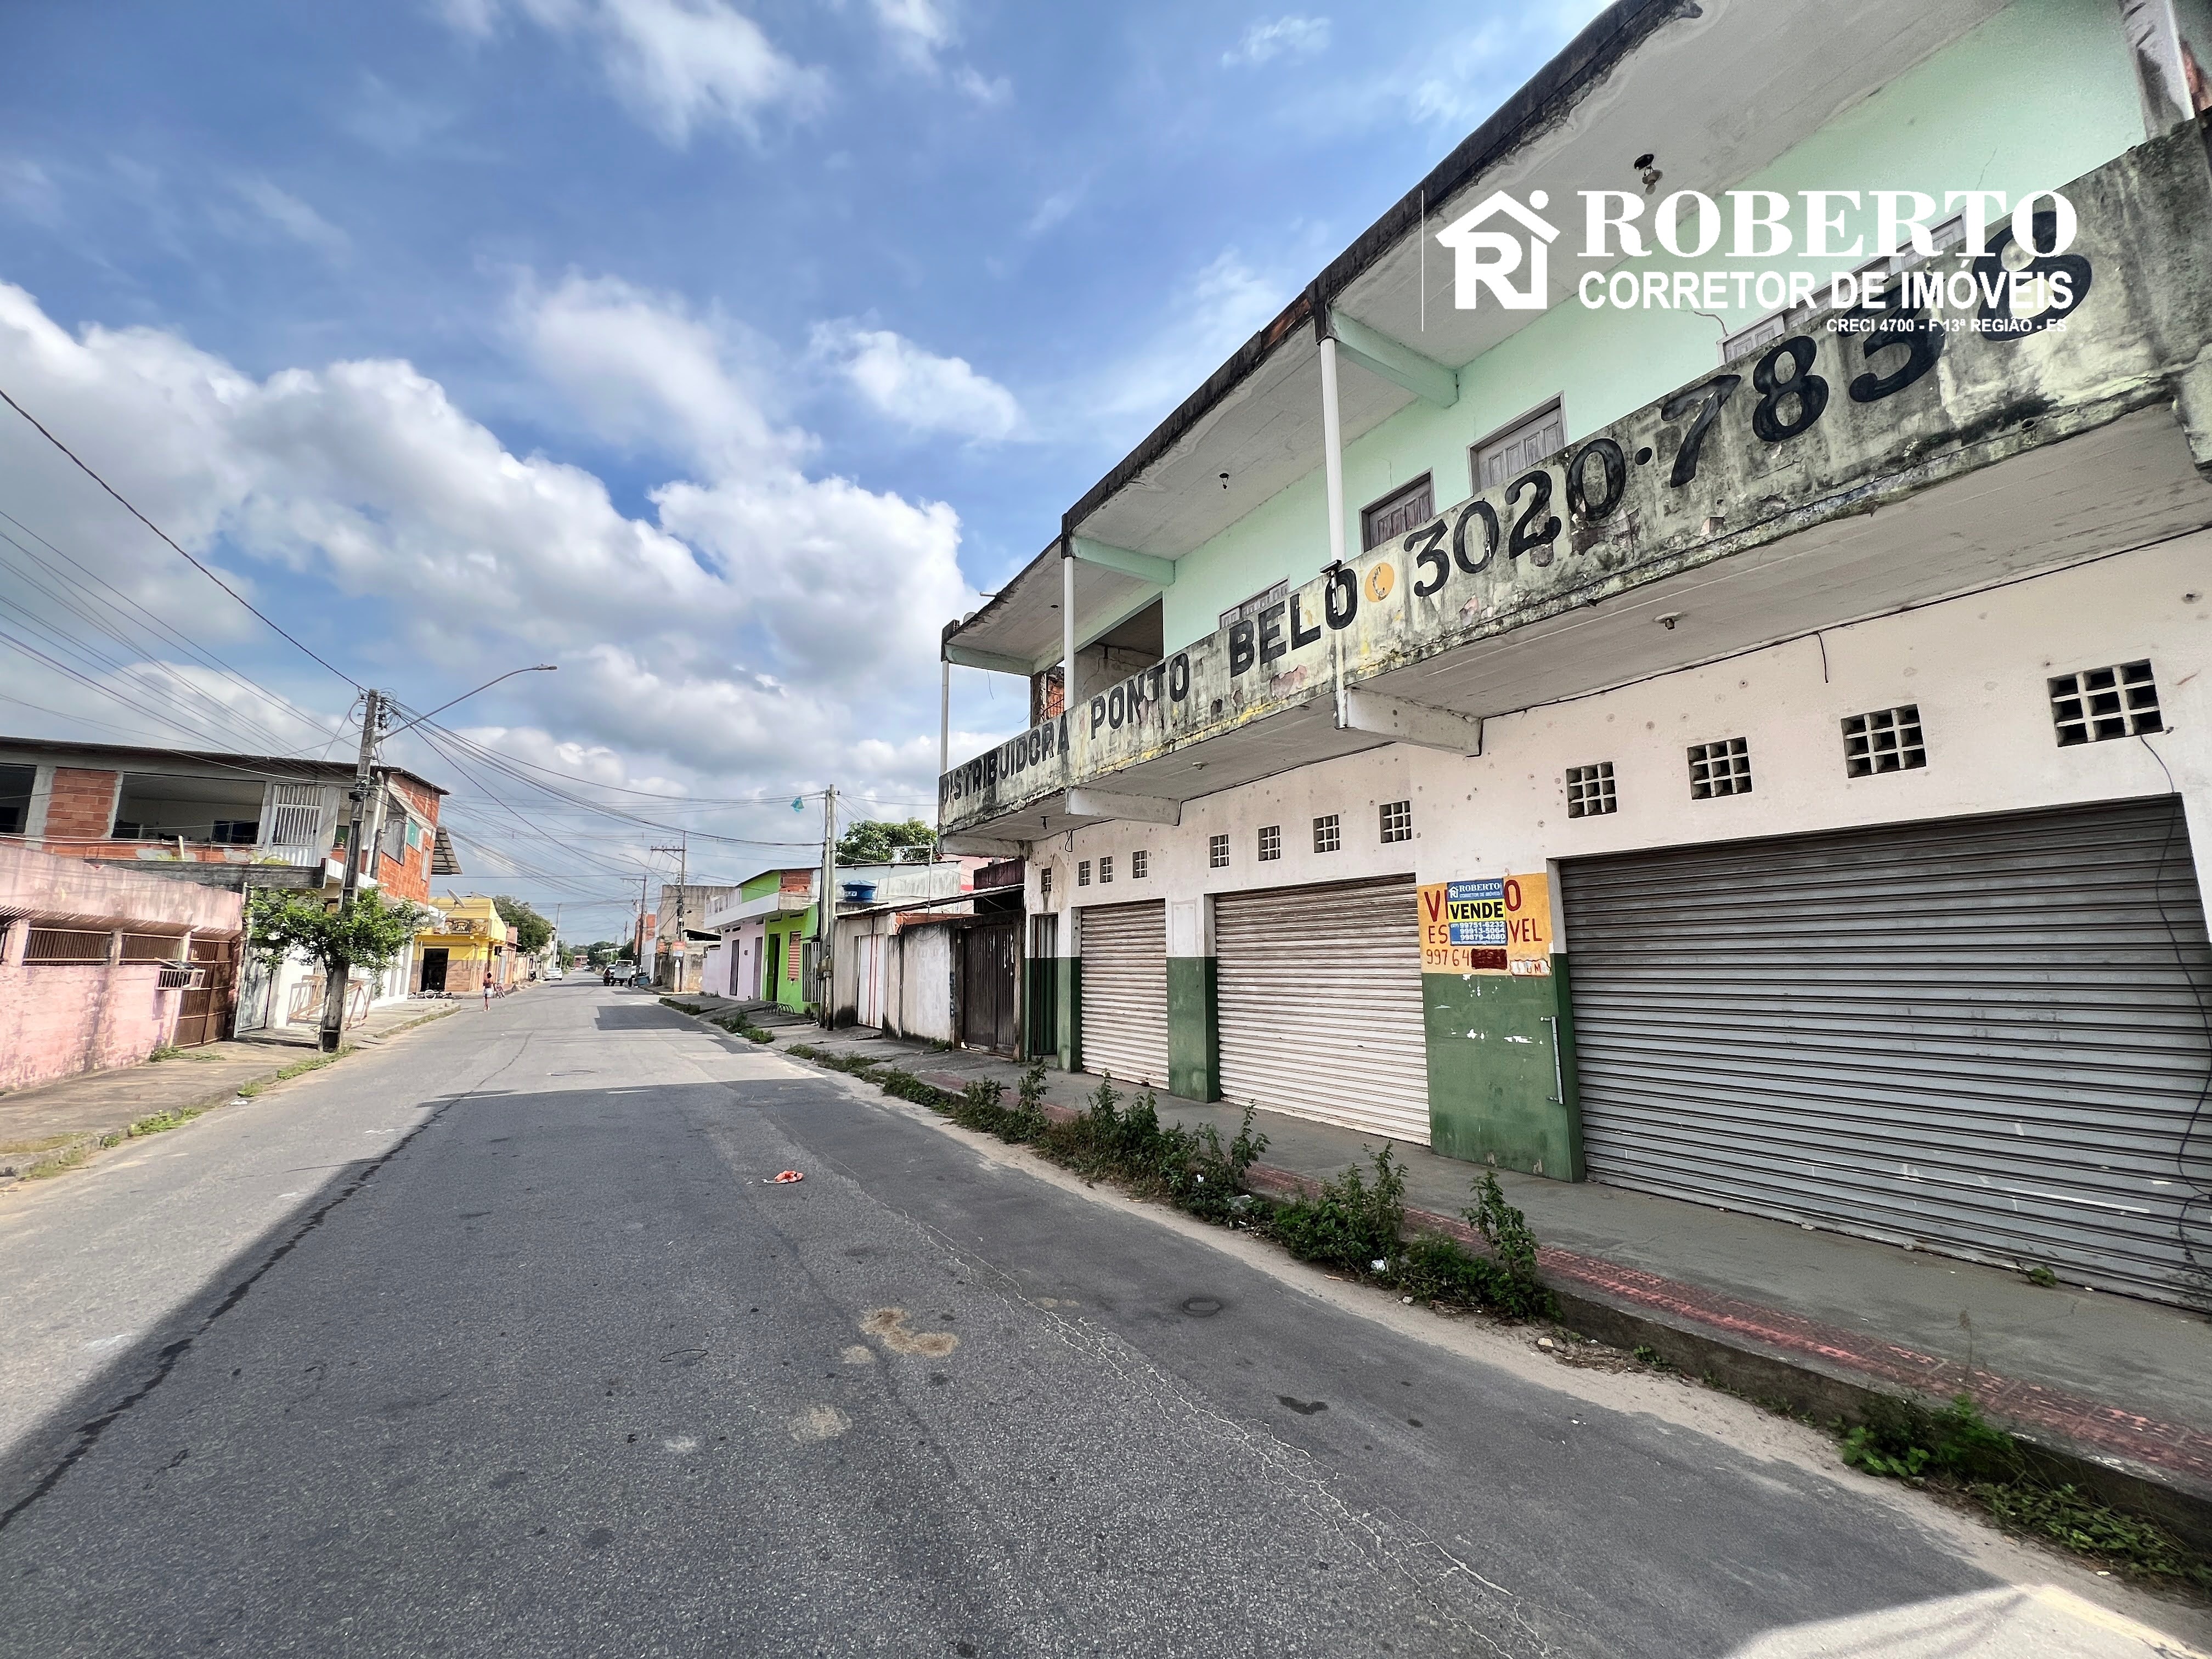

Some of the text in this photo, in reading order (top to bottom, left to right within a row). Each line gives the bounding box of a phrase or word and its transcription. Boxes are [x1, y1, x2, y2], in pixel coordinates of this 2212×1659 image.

[939, 713, 1070, 806] DISTRIBUIDORA
[1091, 652, 1189, 740] PONTO
[1229, 568, 1358, 678] BELO
[1459, 882, 1500, 892] ROBERTO
[1449, 901, 1504, 919] VENDE
[1428, 918, 1543, 944] ES VEL
